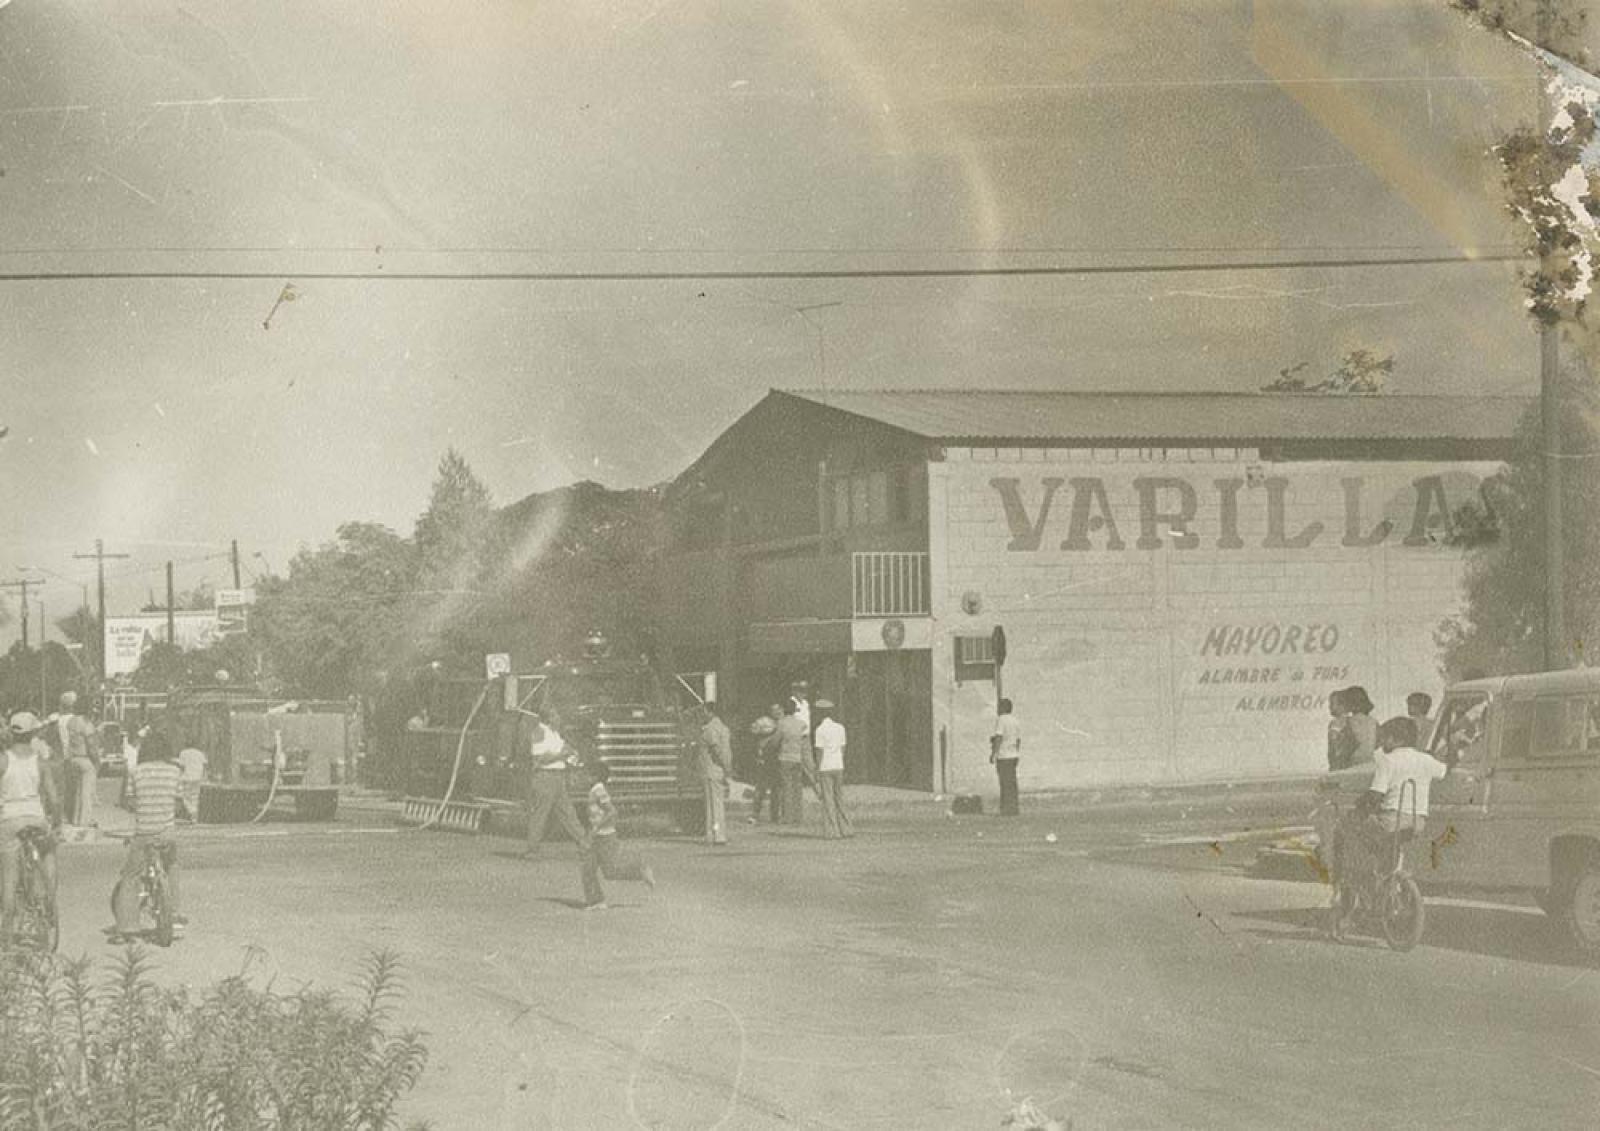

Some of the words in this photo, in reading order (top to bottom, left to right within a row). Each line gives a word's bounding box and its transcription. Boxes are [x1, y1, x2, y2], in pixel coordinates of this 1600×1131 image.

[1202, 624, 1338, 657] MAYOREO
[1200, 667, 1281, 683] ALAMBRE
[1313, 666, 1349, 681] PUAS
